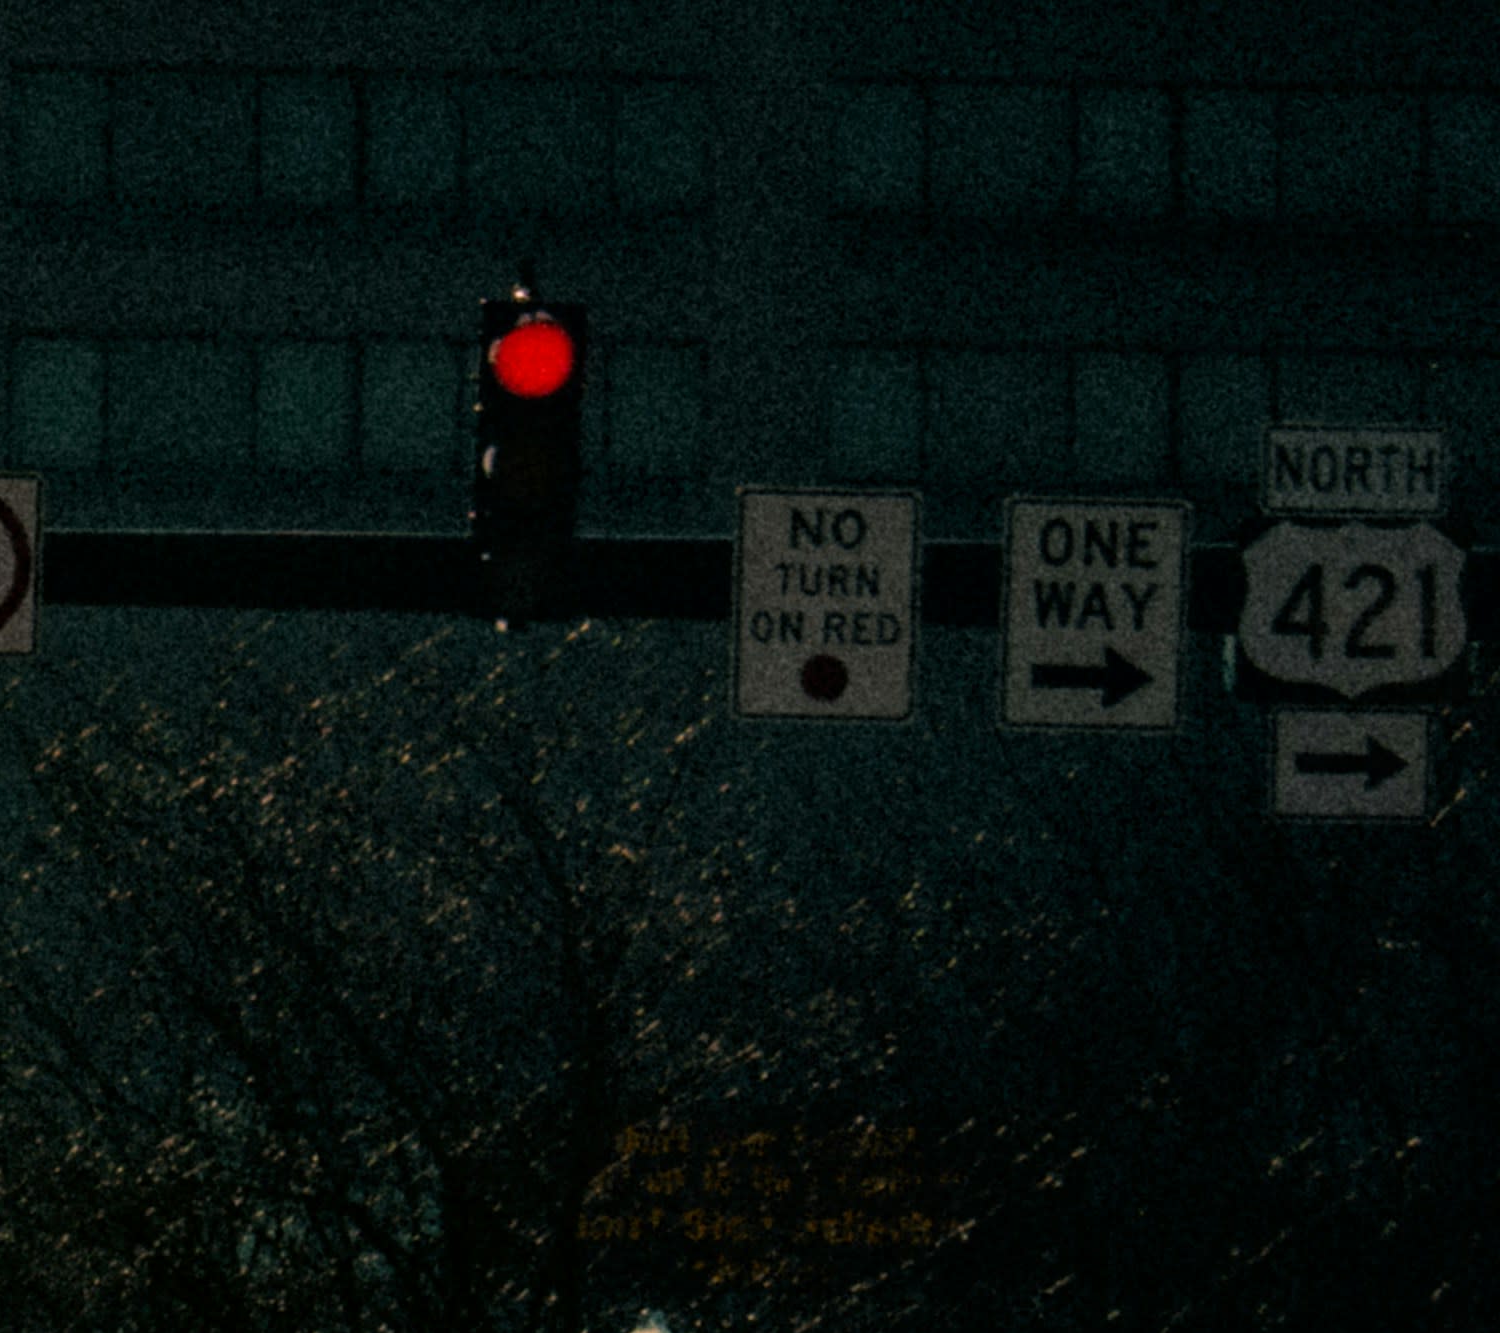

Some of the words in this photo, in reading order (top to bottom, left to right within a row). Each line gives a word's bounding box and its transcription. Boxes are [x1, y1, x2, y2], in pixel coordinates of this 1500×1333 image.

[1275, 443, 1438, 495] NORTH
[788, 508, 868, 548] NO
[1039, 519, 1160, 569] ONE
[775, 562, 881, 598] TURN
[751, 614, 806, 644] ON
[823, 610, 898, 648] RED
[1034, 582, 1158, 632] WAY
[1272, 562, 1440, 660] 421
